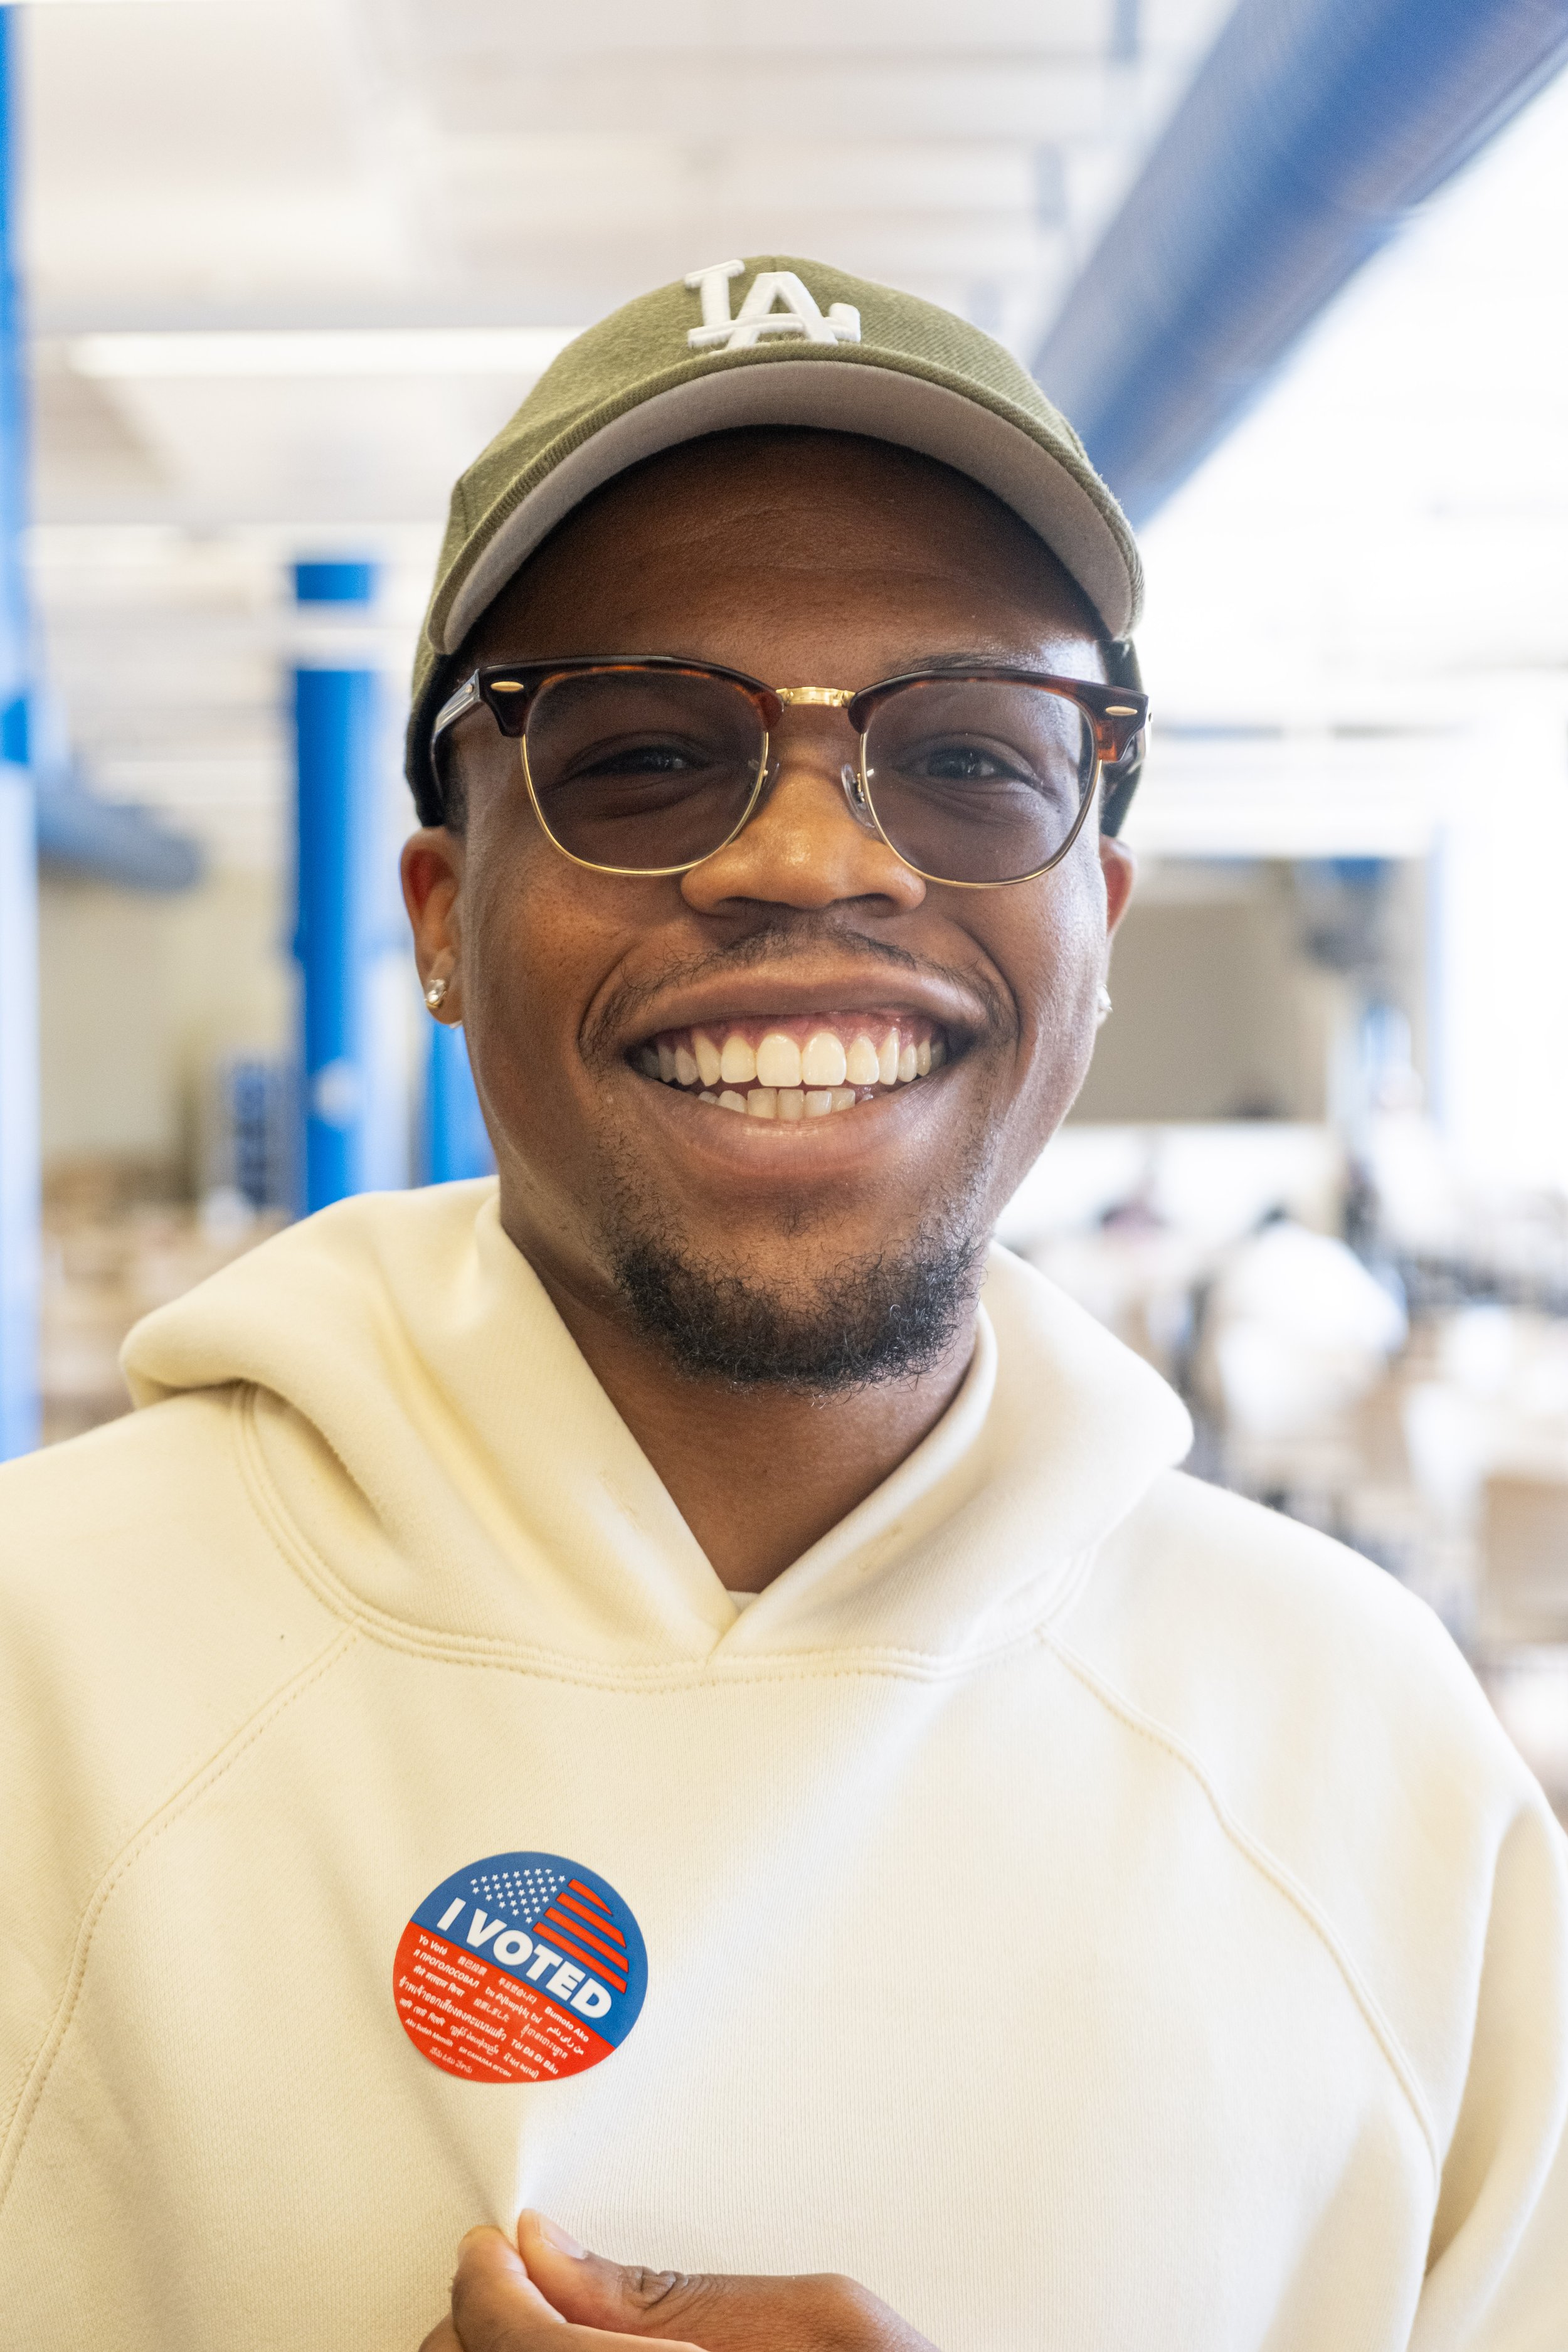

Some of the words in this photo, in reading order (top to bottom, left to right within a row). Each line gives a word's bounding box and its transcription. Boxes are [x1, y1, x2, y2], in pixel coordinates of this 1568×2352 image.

[684, 259, 861, 355] LA
[420, 1934, 428, 1946] Yo
[430, 1941, 448, 1956] Voté
[437, 1898, 465, 1931] I
[467, 1909, 611, 2018] VOTED
[420, 1952, 479, 1988] ПРОГОЛОСОВАЛ
[405, 2018, 416, 2027] Aku
[416, 2024, 432, 2035] Sudah
[432, 2032, 453, 2047] Memilih
[544, 2006, 573, 2030] Bumoto
[573, 2028, 588, 2042] Ako
[511, 2038, 524, 2050] Tôi
